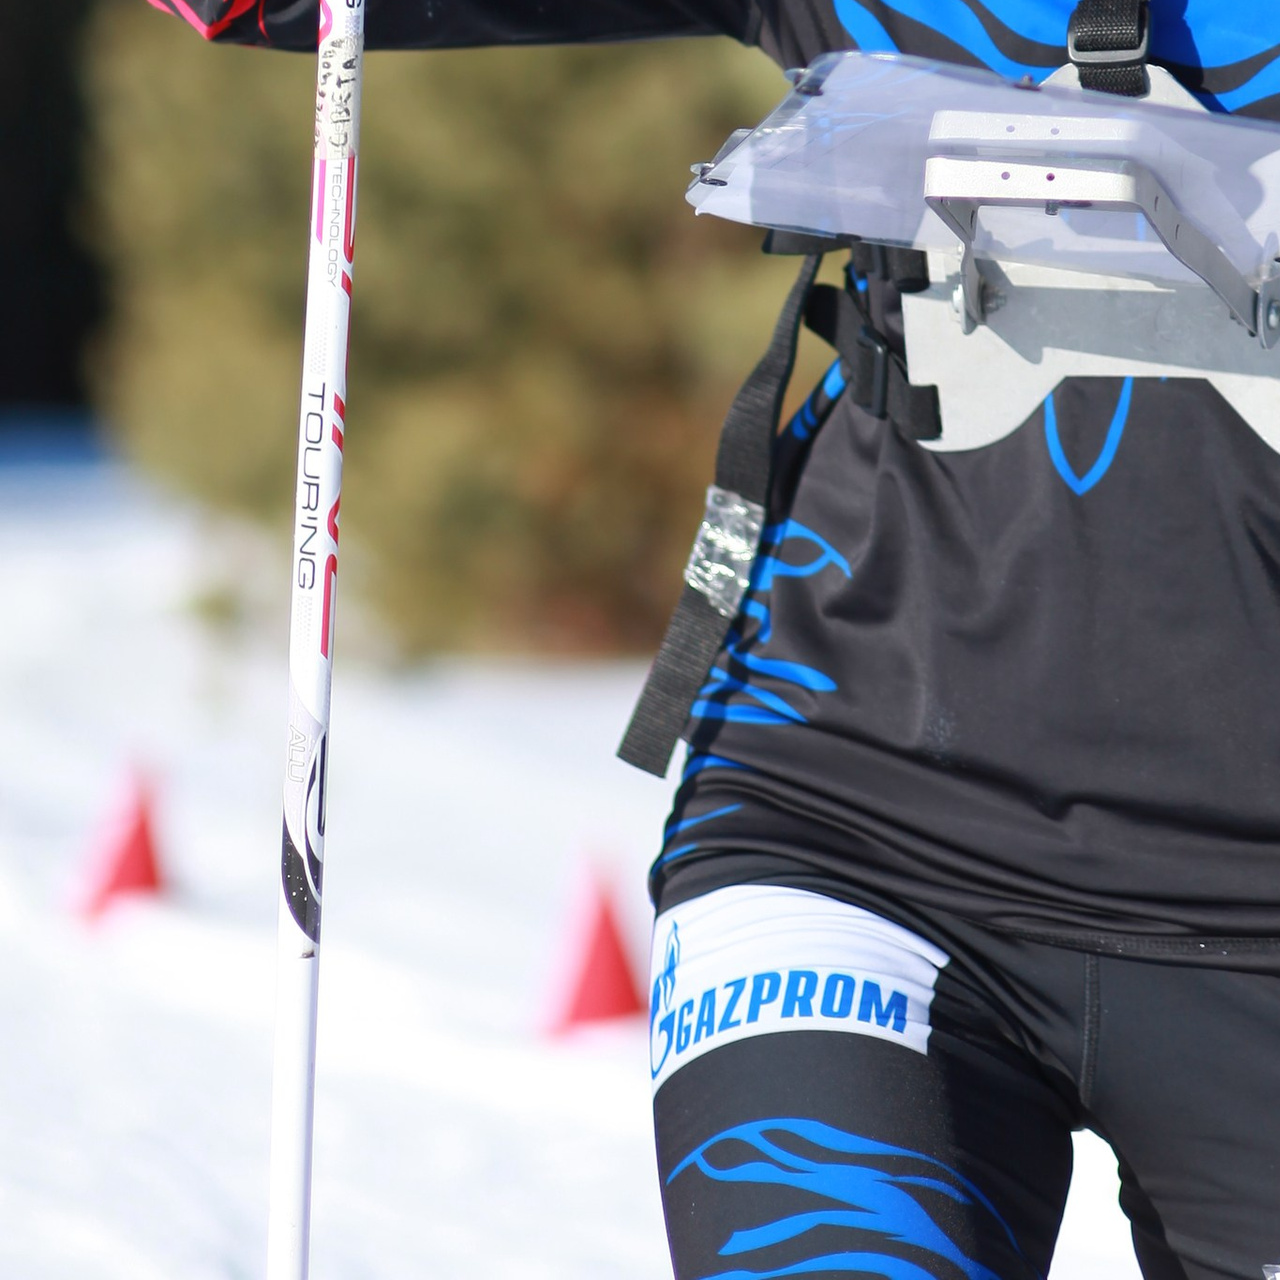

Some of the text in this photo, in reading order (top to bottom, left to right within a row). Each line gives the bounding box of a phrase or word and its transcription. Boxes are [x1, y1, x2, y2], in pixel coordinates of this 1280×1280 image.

[327, 162, 343, 288] TECHNOLOGY
[298, 382, 326, 590] TOURING
[287, 724, 307, 783] ALU
[675, 970, 908, 1055] GAZPROM
